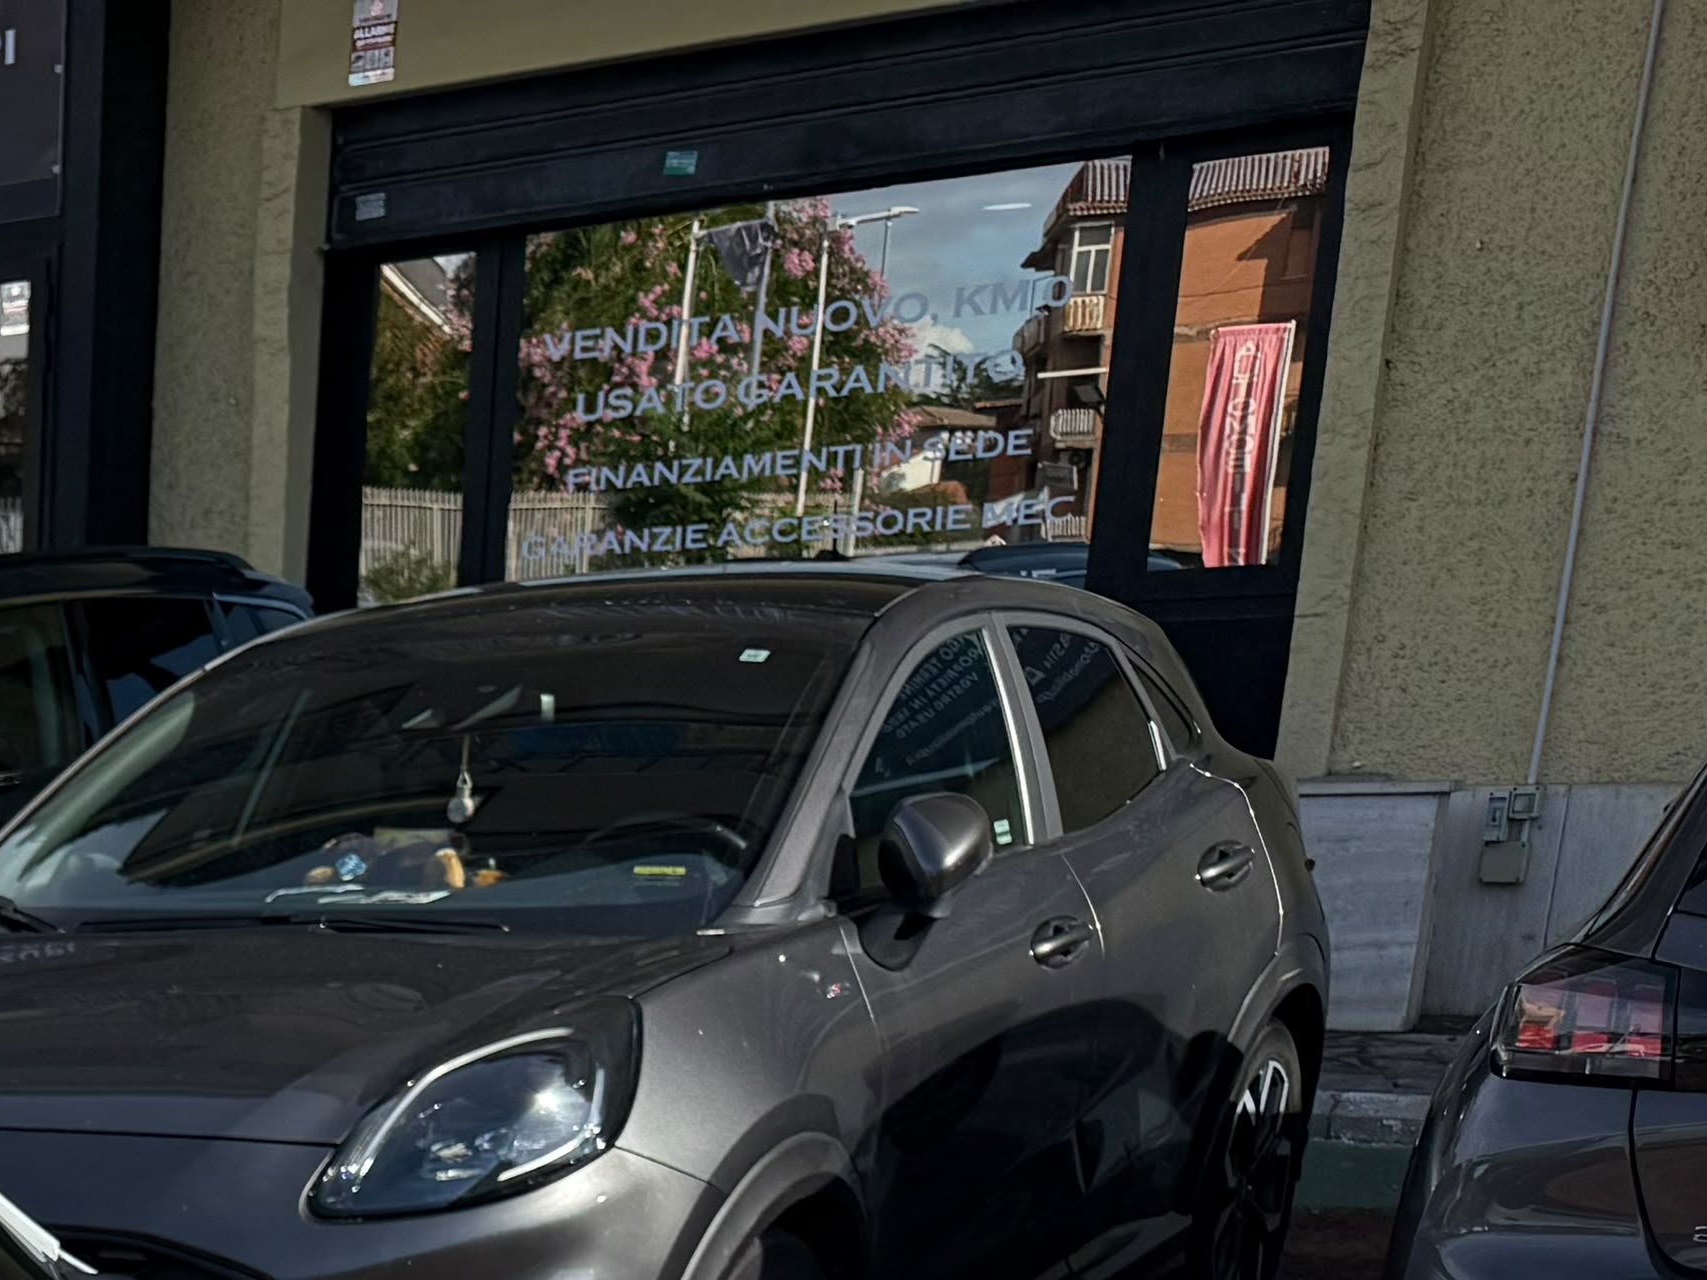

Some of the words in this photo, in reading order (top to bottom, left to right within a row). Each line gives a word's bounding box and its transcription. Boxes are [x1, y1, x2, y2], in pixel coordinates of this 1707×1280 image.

[544, 315, 740, 362] VENDITA
[951, 279, 1031, 318] KM
[573, 377, 727, 423] USATO
[737, 350, 1024, 403] GARANTITO
[566, 443, 864, 493] FINANZIAMENTI
[873, 438, 912, 468] IN
[923, 430, 1034, 463] SEDE
[520, 523, 708, 562] GARANZIE
[718, 504, 973, 549] ACCESSORIE
